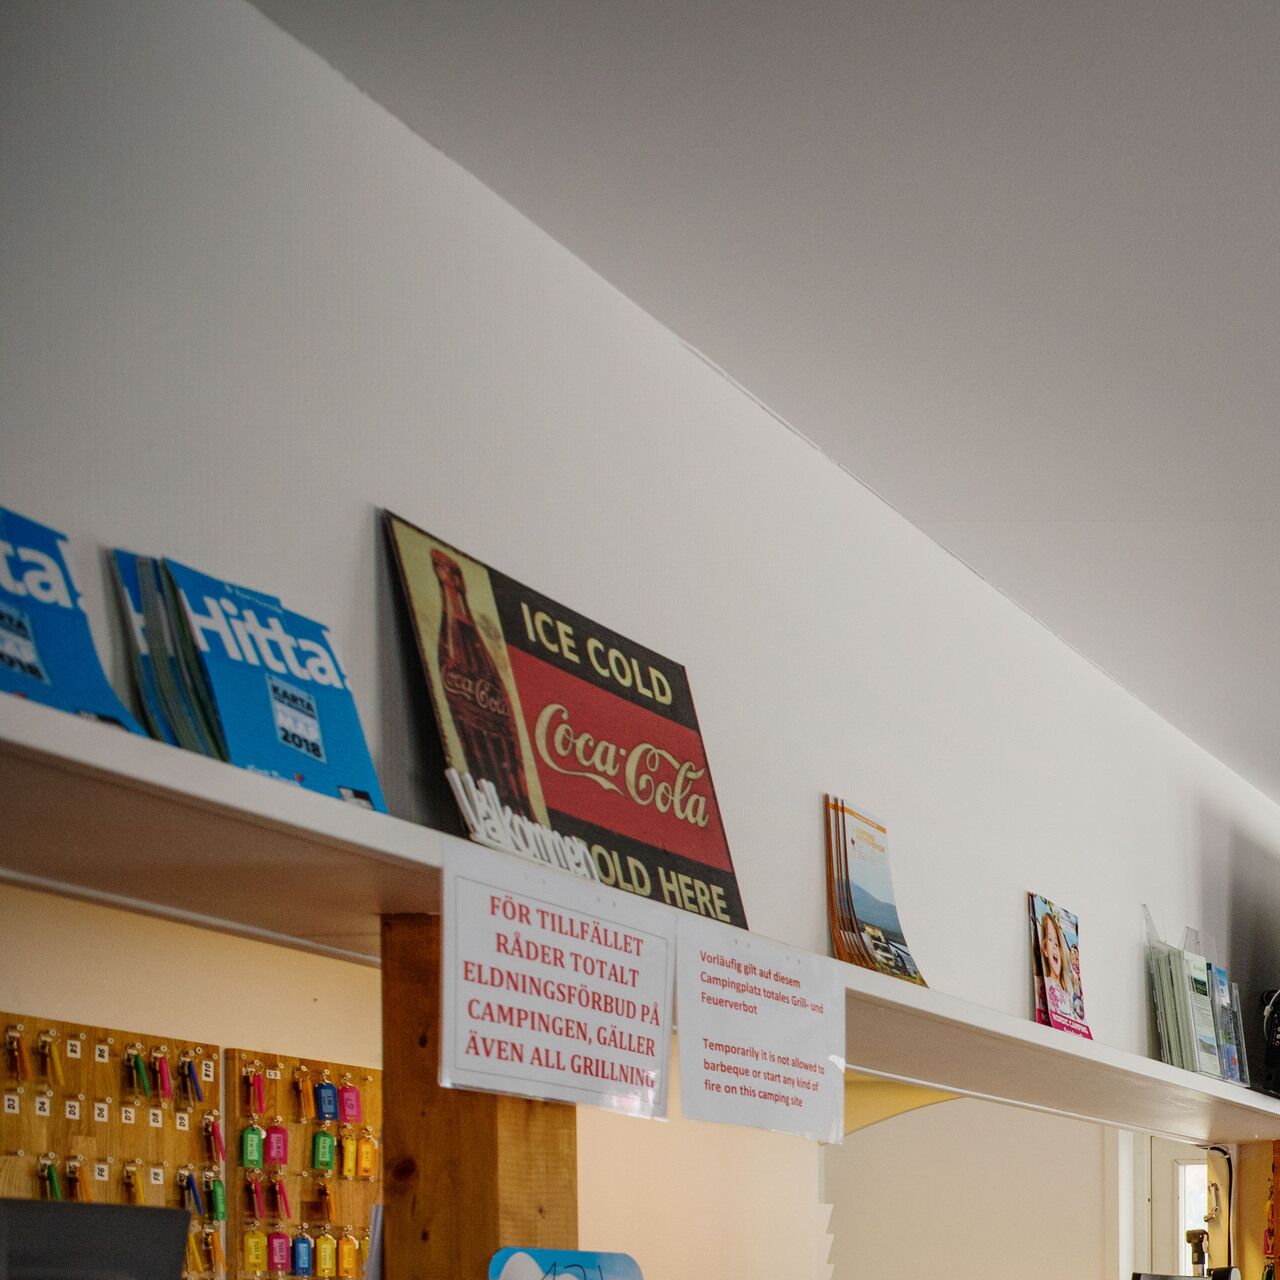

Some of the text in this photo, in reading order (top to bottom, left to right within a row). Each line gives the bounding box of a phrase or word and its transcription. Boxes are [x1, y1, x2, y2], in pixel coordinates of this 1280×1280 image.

[520, 601, 673, 706] ICE COLD
[271, 683, 316, 712] KARTA
[280, 727, 323, 759] 2018
[590, 845, 731, 923] OLD HERE
[489, 894, 645, 958] FÖR TILLFÄLLET
[496, 929, 640, 988] RÅDER TOTALT
[700, 949, 802, 989] Vorläufig gilt auf diesem
[463, 960, 661, 1027] ELDNINGSFÖRBUD PÅ
[700, 971, 762, 1004] Campingplatz
[763, 985, 791, 1006] totales
[810, 999, 825, 1015] und
[700, 991, 759, 1017] Feuerverbot
[467, 997, 656, 1058] CAMPINGEN, GÄLLER
[465, 1030, 657, 1090] ÄVEN ALL GRILLNING
[703, 1037, 760, 1064] Temporarily
[778, 1053, 791, 1068] not
[792, 1055, 818, 1074] allowed
[818, 1063, 826, 1075] to
[703, 1059, 751, 1082] barbeque
[751, 1069, 762, 1080] or
[763, 1070, 782, 1085] start
[783, 1074, 797, 1091] any
[797, 1074, 813, 1091] kind
[704, 1078, 803, 1109] fire on this camping site
